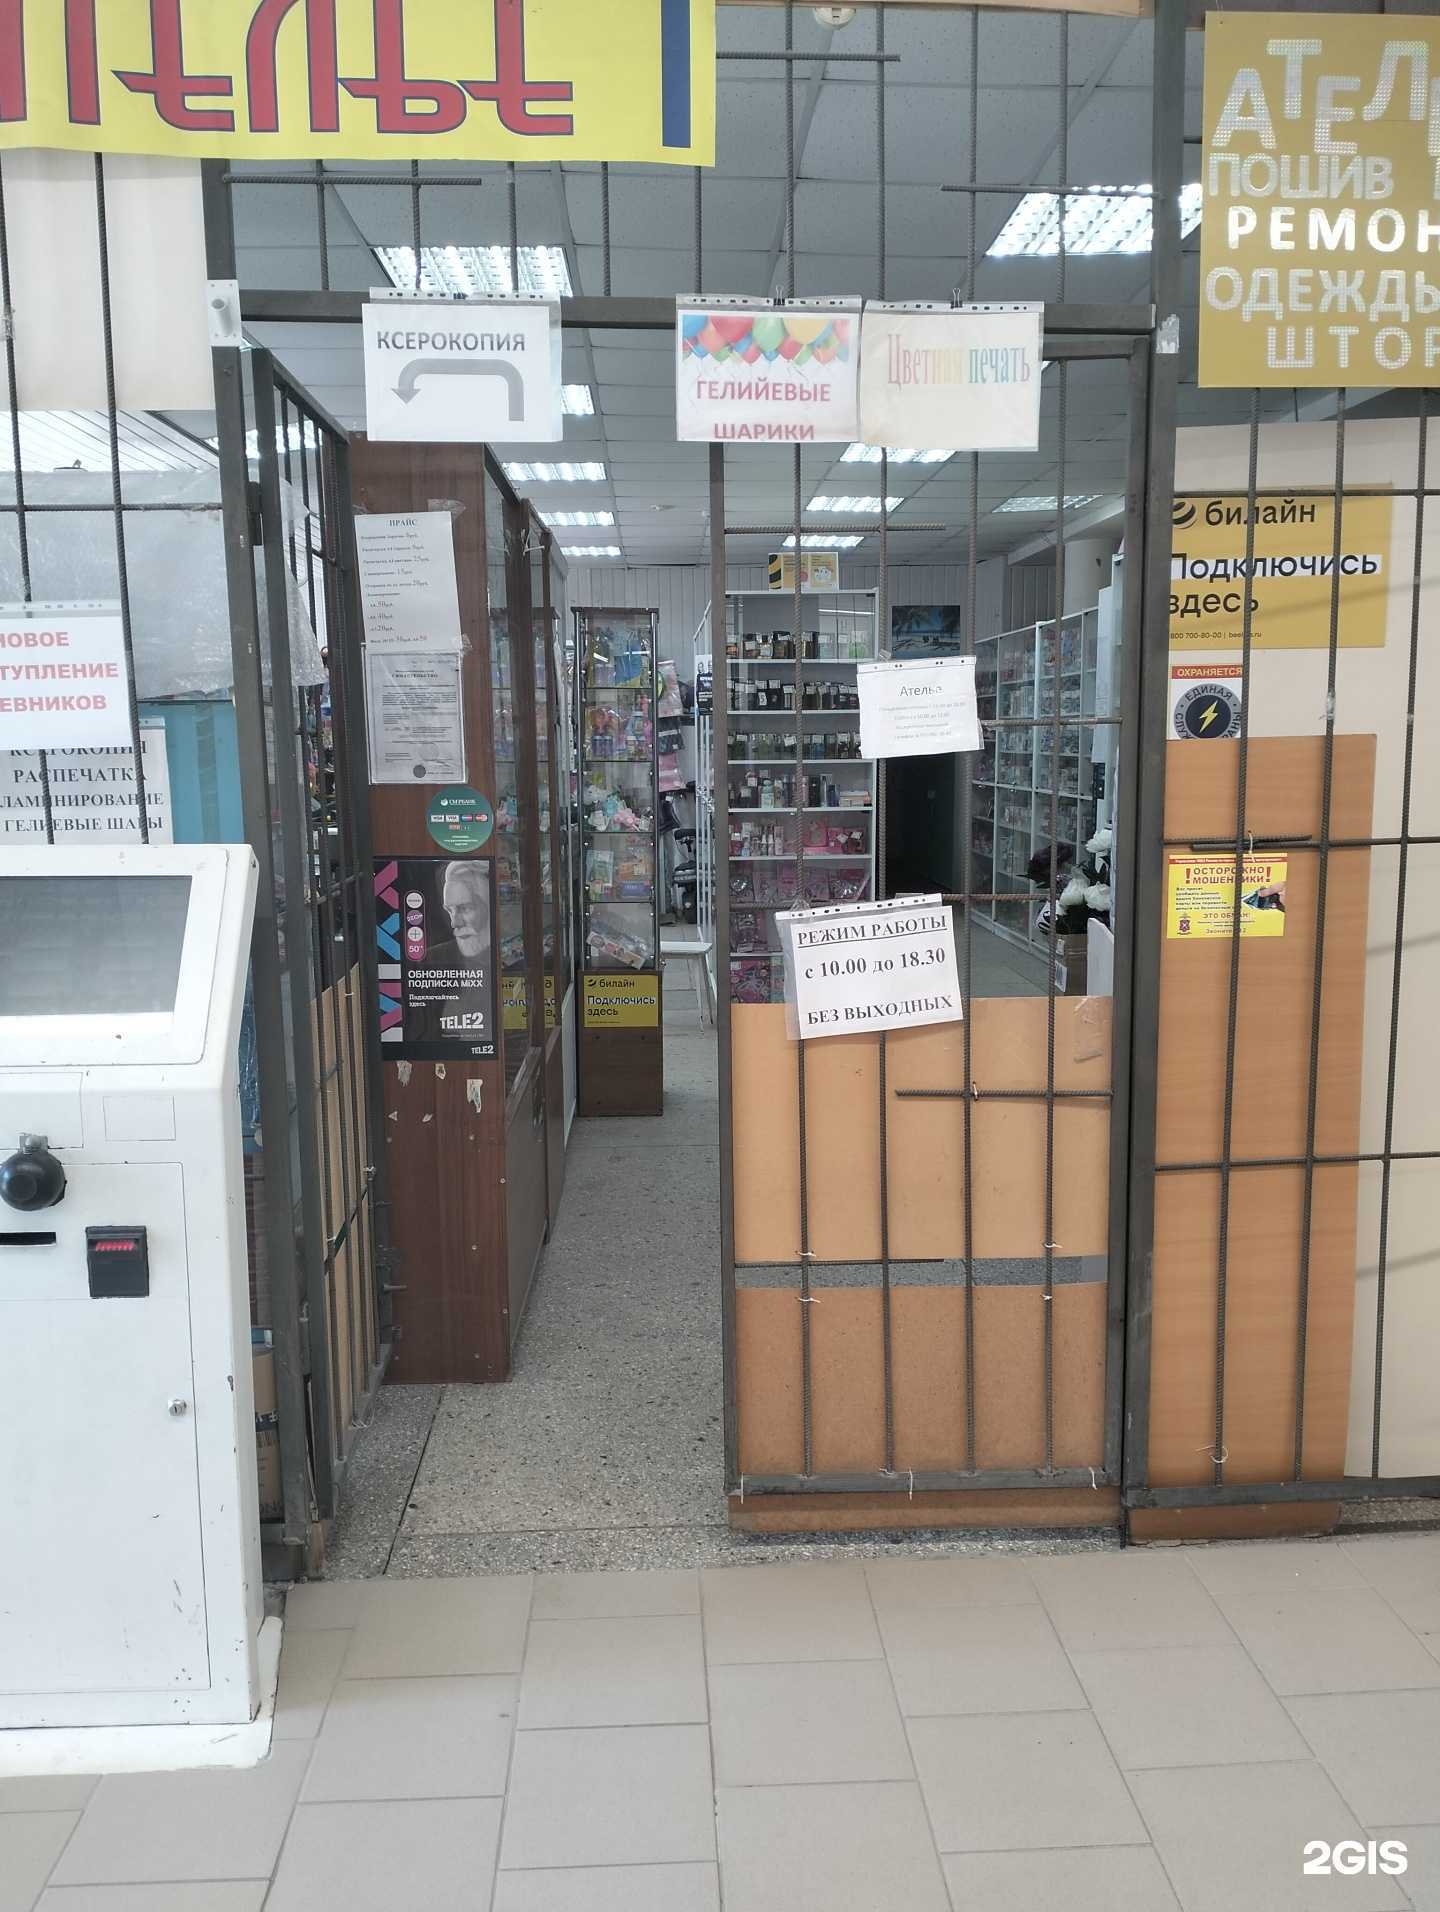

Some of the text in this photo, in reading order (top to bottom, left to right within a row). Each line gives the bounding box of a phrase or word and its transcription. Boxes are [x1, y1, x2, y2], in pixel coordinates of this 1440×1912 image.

[1208, 152, 1394, 200] ПОШИВ
[376, 330, 526, 352] КСЕРОКОПИЯ
[968, 346, 1031, 384] печать
[696, 376, 831, 403] ГЕЛИЙЕВЫЕ
[713, 423, 815, 441] ШАРИКИ
[1177, 667, 1243, 677] ОХРАНЯЕТСЯ
[1185, 685, 1233, 702] ЕДИНАЯ
[14, 767, 148, 783] РАПЕЧАТК
[0, 793, 165, 808] ЛАМНИРОВАНЕ
[107, 816, 163, 830] ШАЫ
[1192, 876, 1264, 884] МОШЕНИКИ
[798, 915, 946, 945] РЕЖИМ РАБОТЫ
[805, 947, 945, 979] с 10.00 до 18.30
[408, 969, 483, 979] ОБНОВЛЕННАЯ
[408, 980, 459, 988] ПОДПИСКА
[599, 978, 635, 988] билайн
[587, 995, 655, 1005] Подключись
[587, 1008, 618, 1016] здесь
[807, 995, 953, 1025] БЕЗ ВЫХОДНЫХ
[440, 1012, 484, 1029] TELE2
[471, 1045, 494, 1054] TELE2
